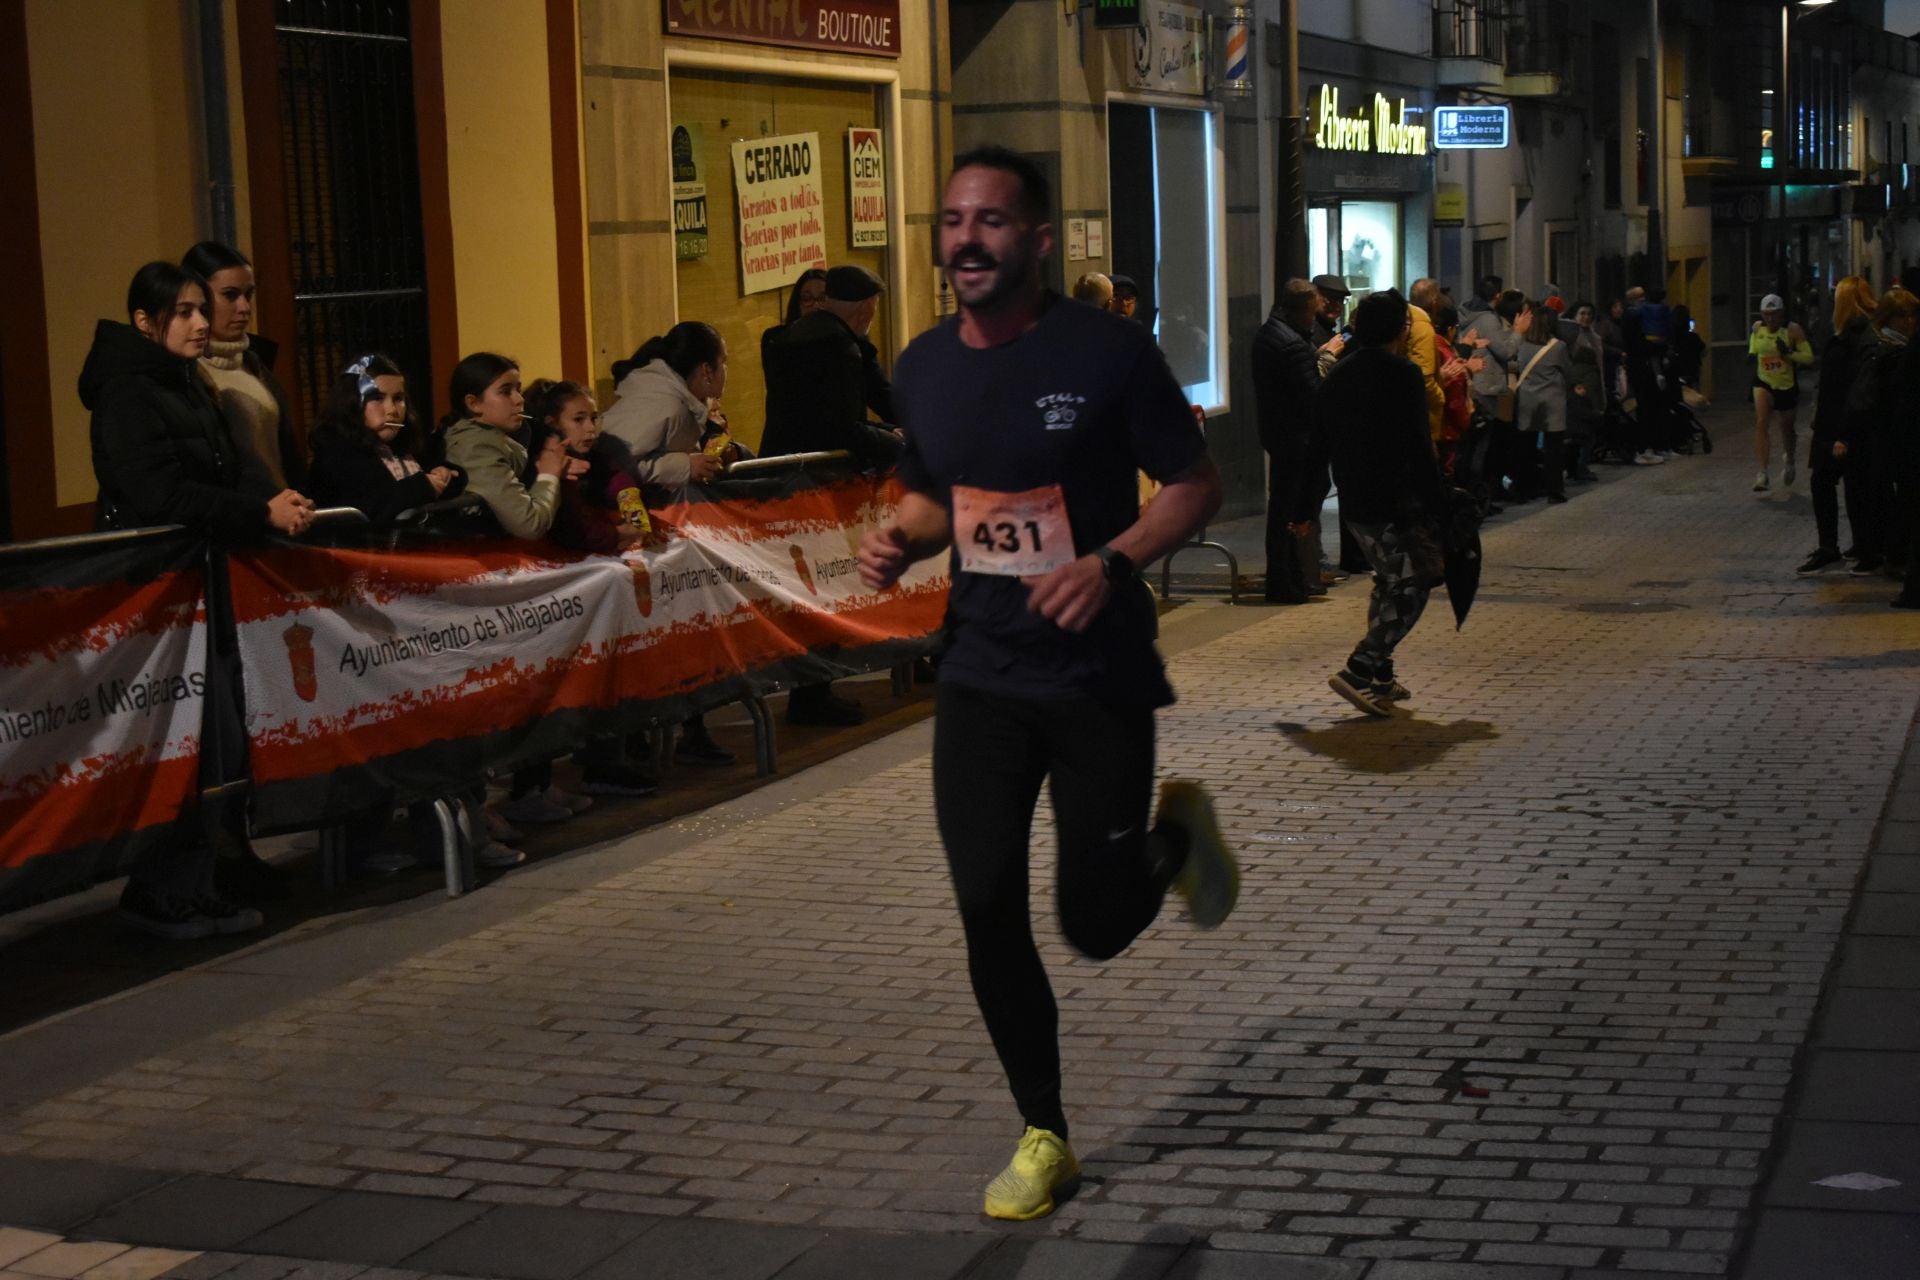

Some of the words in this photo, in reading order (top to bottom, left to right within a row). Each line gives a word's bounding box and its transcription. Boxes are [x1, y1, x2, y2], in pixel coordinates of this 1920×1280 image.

[817, 8, 892, 47] BOUTIQUE
[1374, 92, 1426, 155] Moderna
[1460, 125, 1501, 134] Moderna
[744, 141, 811, 185] CERRADO
[854, 156, 881, 178] CIEM
[741, 191, 777, 220] Gracias
[780, 196, 788, 213] a
[854, 195, 885, 223] ALQUILA
[743, 221, 779, 248] Gracias
[781, 222, 798, 248] por
[744, 247, 780, 275] Gracias
[782, 249, 797, 275] por
[799, 243, 824, 264] tanto.
[973, 521, 1043, 553] 431
[814, 556, 858, 585] Ayuntamie
[339, 625, 470, 677] Ayuntamiento
[474, 615, 498, 642] de
[497, 595, 584, 635] Miajadas
[97, 672, 207, 717] Miajadas
